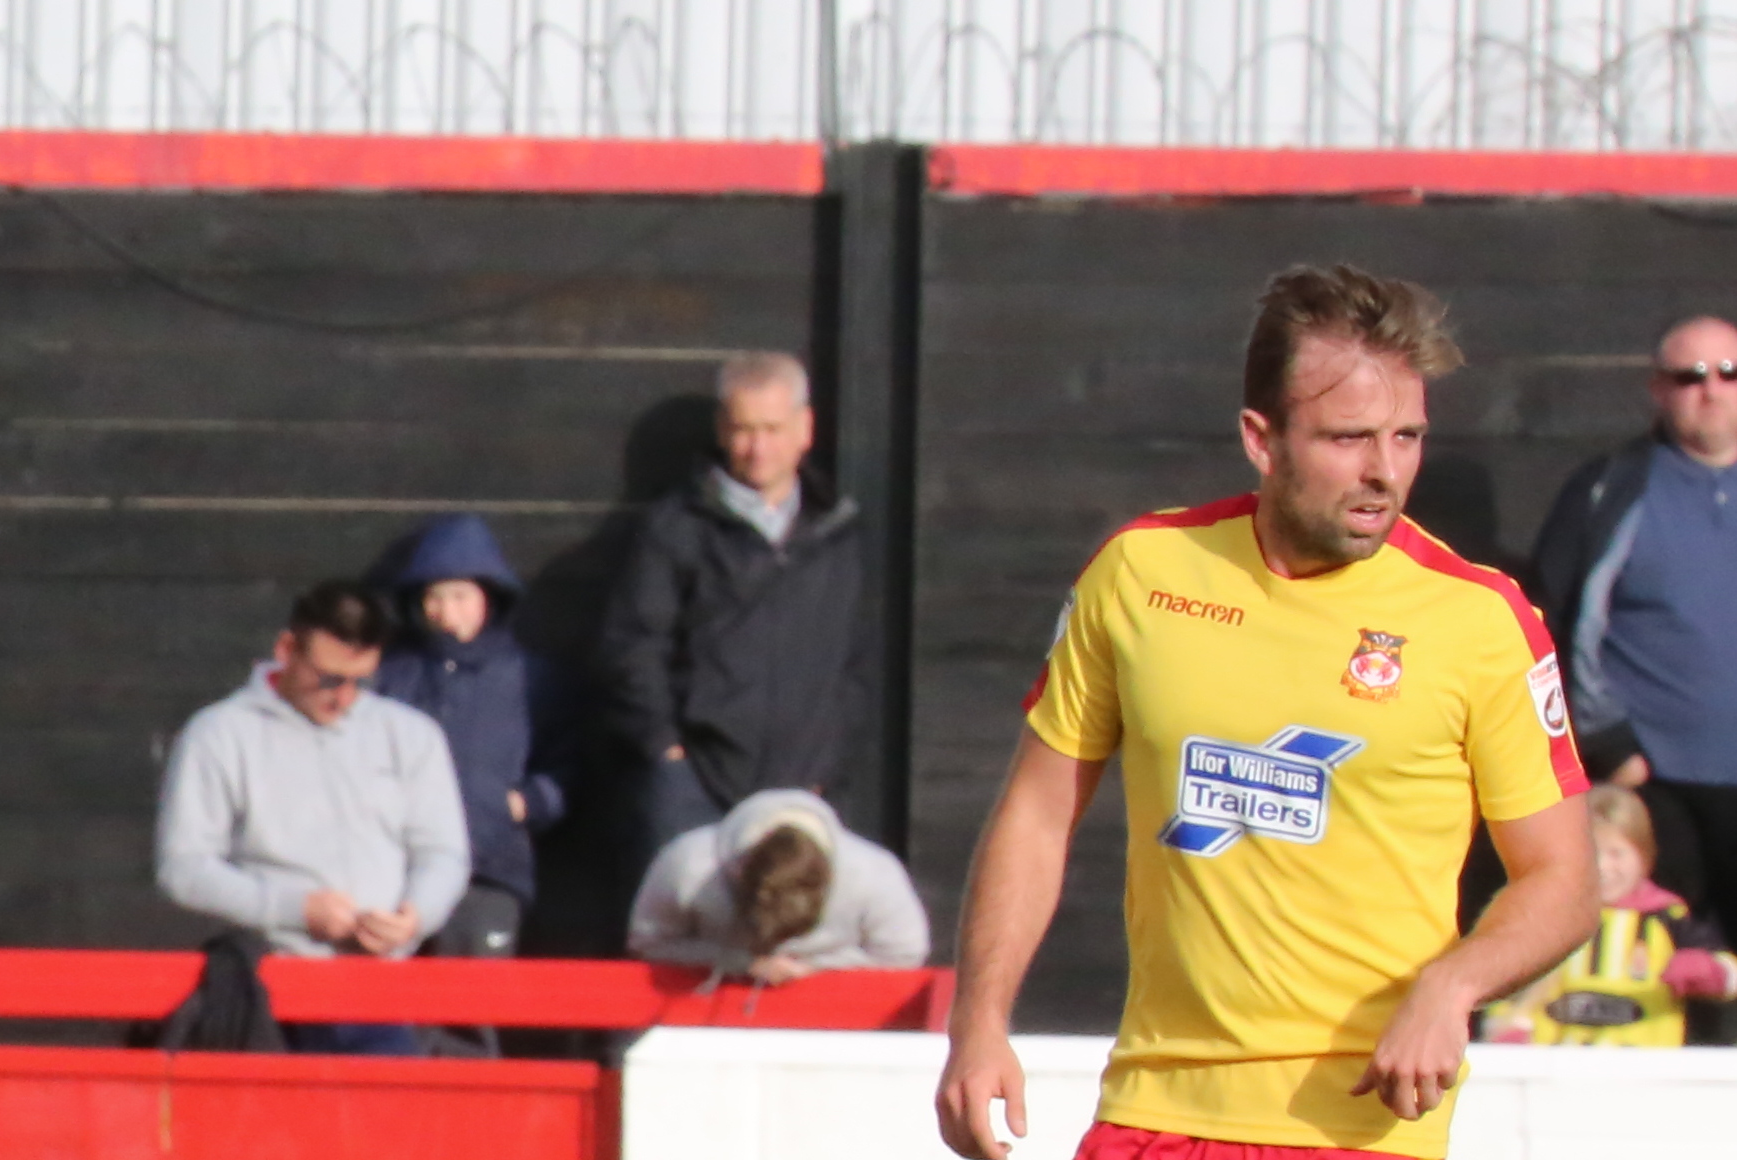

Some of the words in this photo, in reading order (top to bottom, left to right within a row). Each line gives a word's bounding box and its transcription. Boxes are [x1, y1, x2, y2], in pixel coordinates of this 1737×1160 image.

[1147, 589, 1245, 627] macron
[1190, 747, 1226, 774] Ifor
[1229, 755, 1318, 793] Williams
[1189, 781, 1312, 828] Trailers
